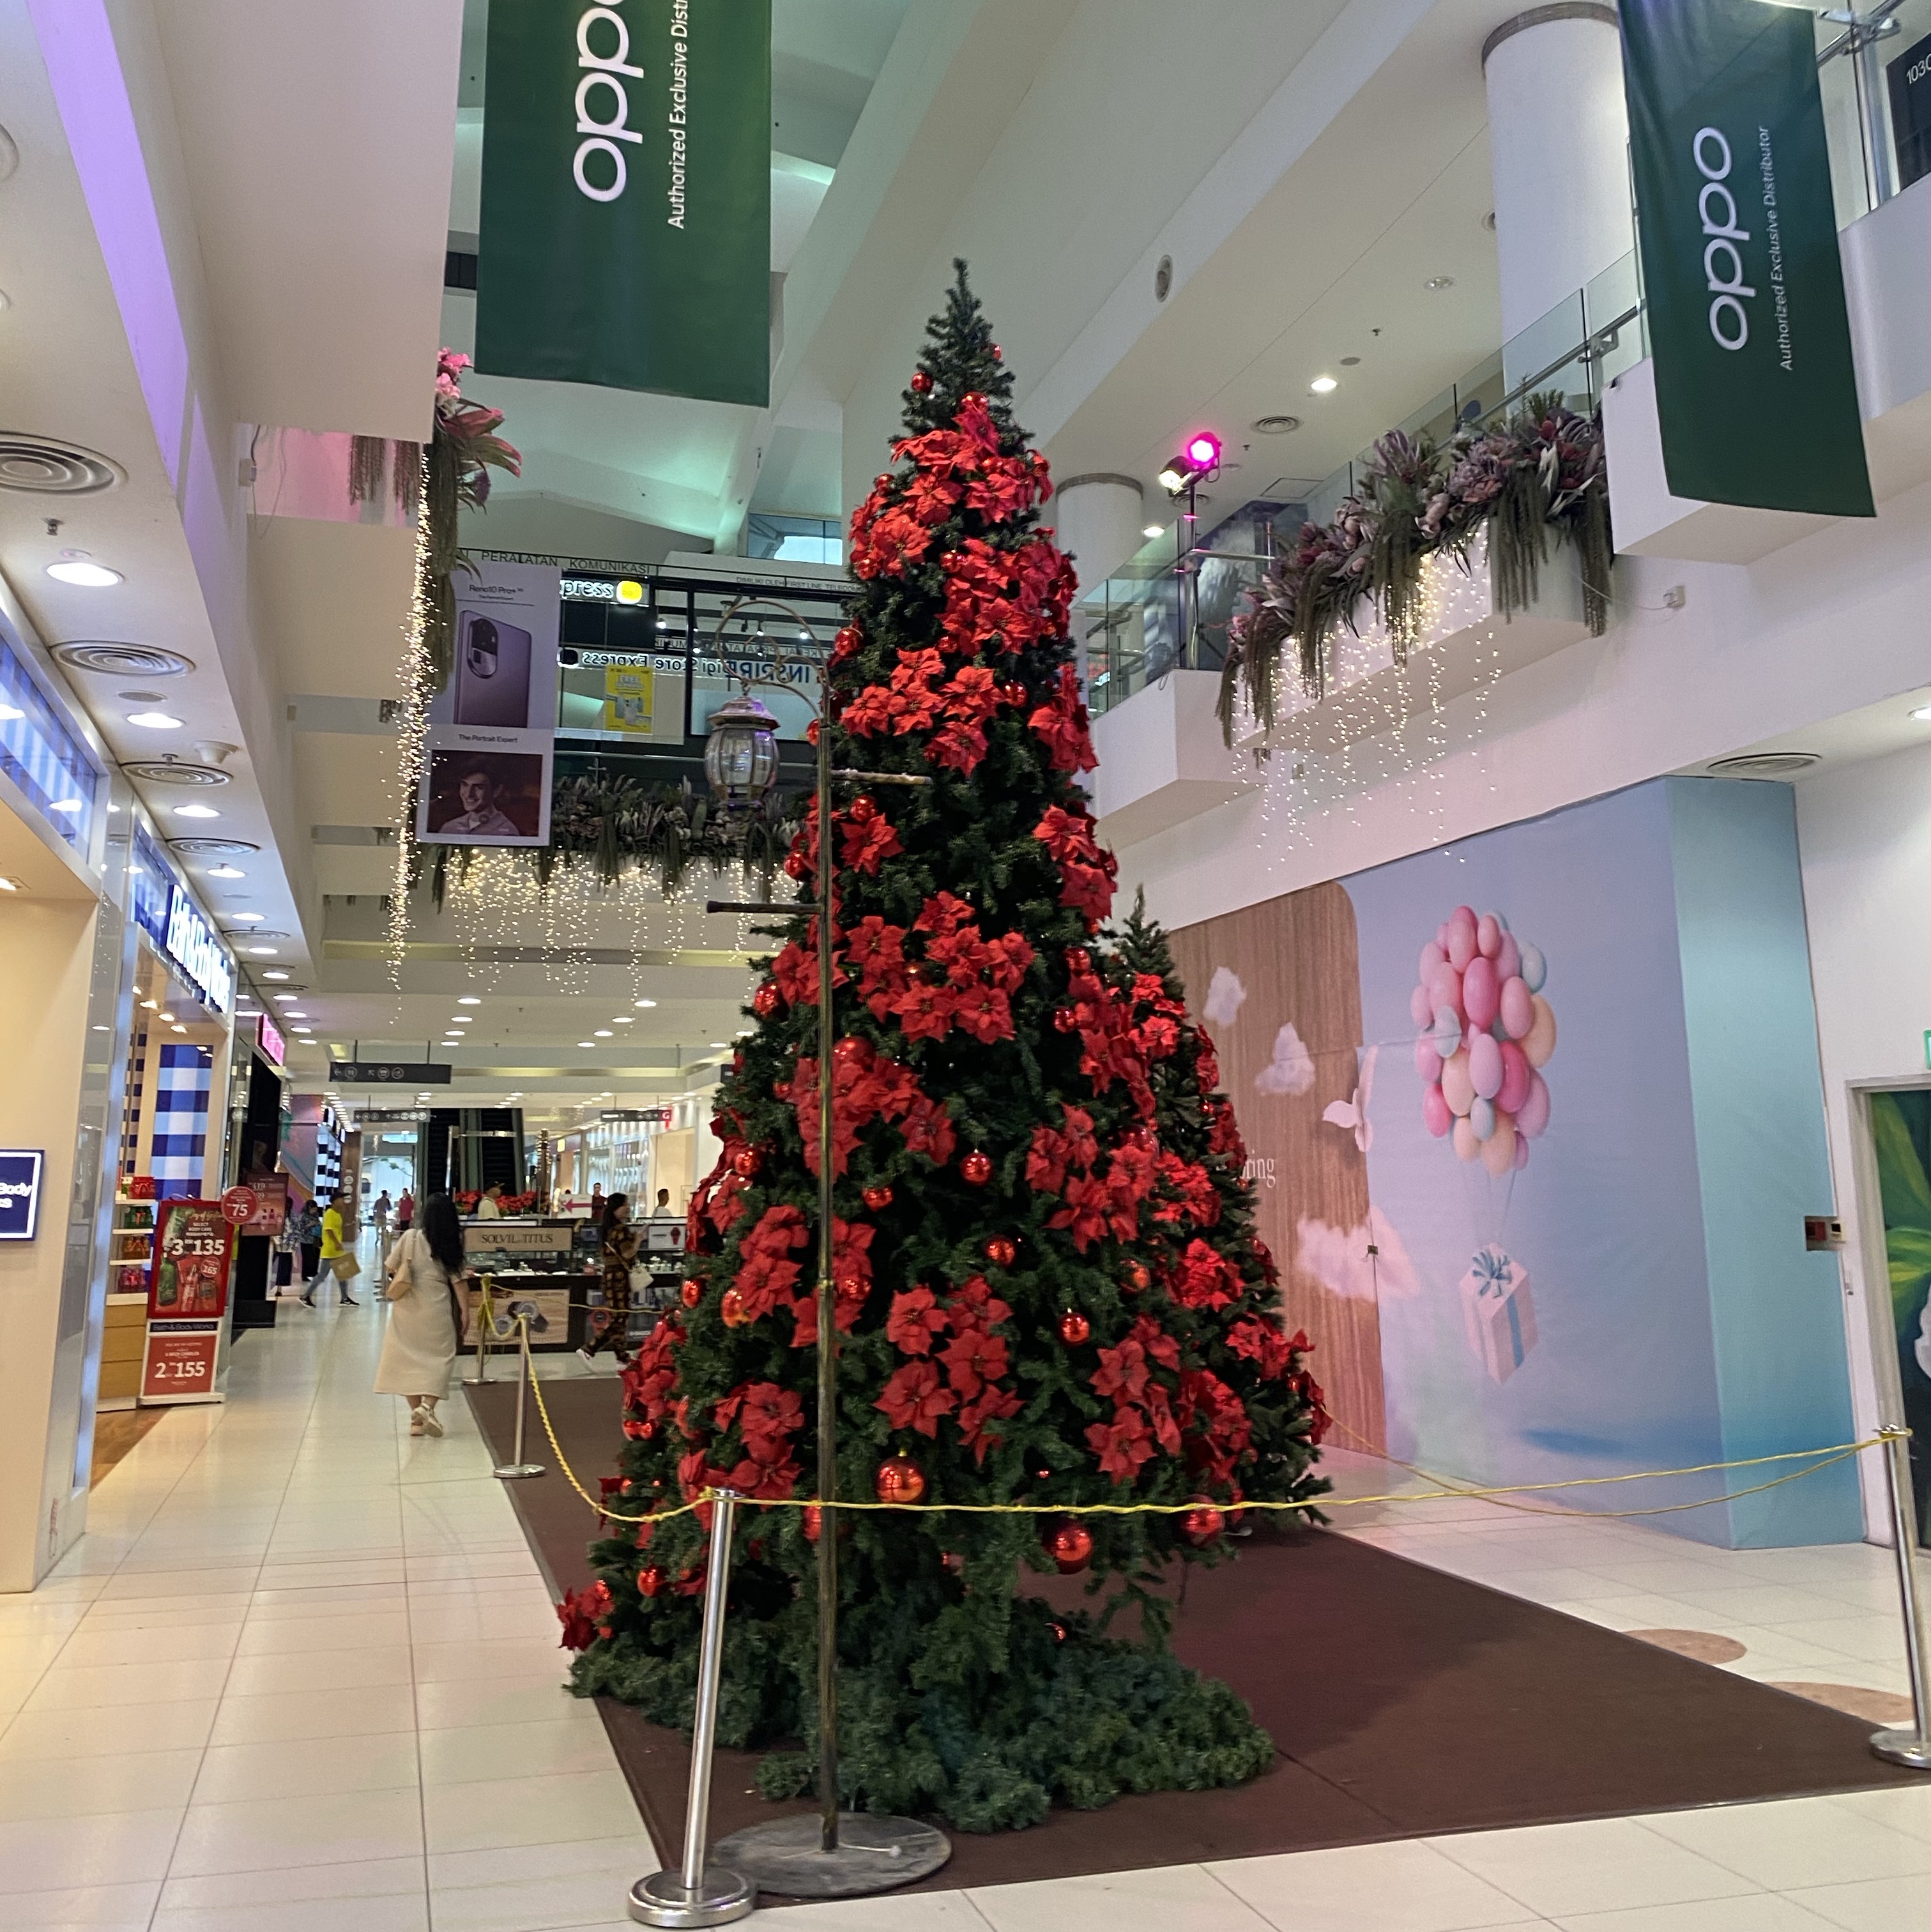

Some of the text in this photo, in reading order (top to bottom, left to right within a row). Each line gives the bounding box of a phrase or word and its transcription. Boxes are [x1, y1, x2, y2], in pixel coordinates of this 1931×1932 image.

[669, 42, 688, 125] Exclusive
[572, 0, 644, 202] opp
[667, 130, 686, 229] Authorized
[1693, 126, 1756, 351] oppo
[1759, 126, 1793, 371] Authorized Exclusive Distributor
[481, 551, 558, 567] PERALATAN
[569, 558, 650, 574] KOMUNIKASI
[469, 584, 498, 593] Reno10
[232, 1204, 248, 1217] 75
[171, 1239, 183, 1256] 3
[192, 1239, 225, 1256] 135
[482, 1234, 518, 1244] SOLVIL
[523, 1234, 554, 1244] TITUS
[202, 1265, 218, 1275] 165
[155, 1361, 206, 1378] 2 155
